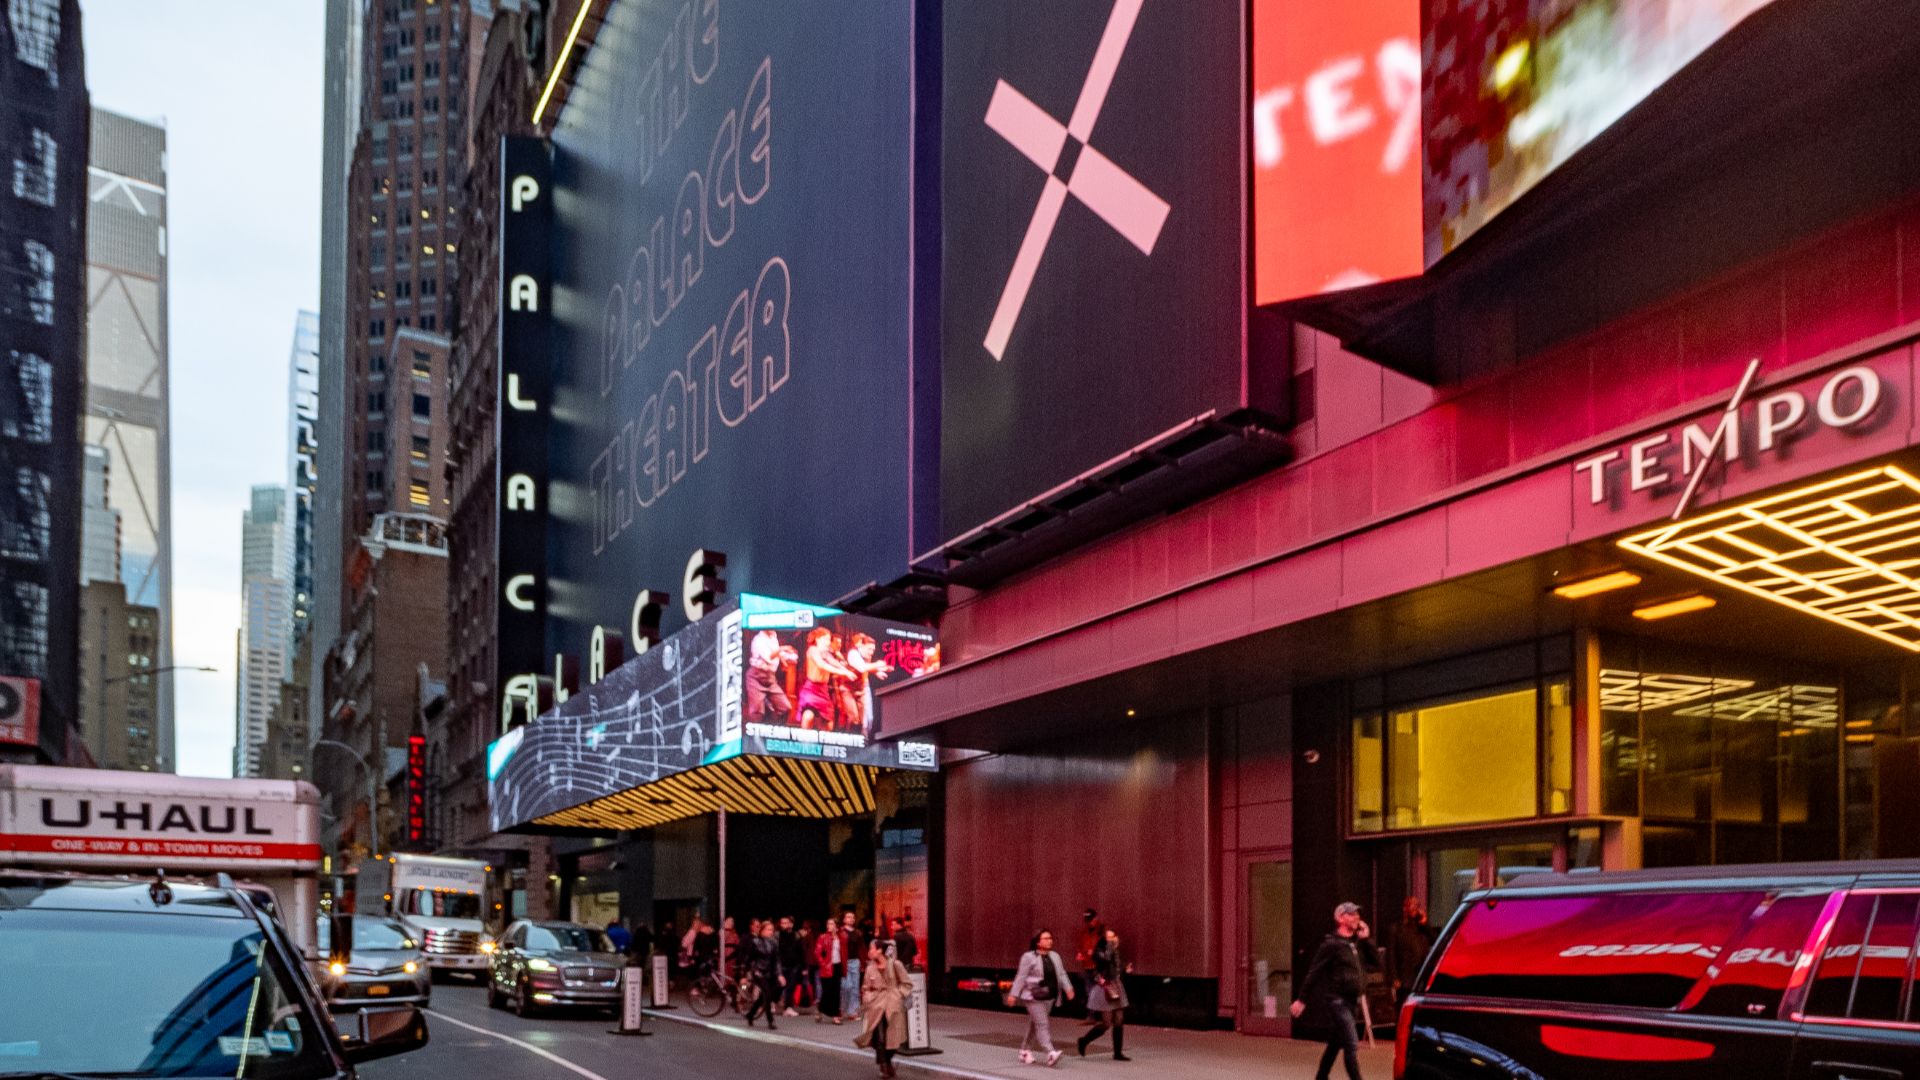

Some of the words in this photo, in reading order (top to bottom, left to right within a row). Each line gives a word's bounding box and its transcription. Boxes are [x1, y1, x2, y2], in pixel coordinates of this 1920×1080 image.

[600, 55, 772, 398] PALACE
[589, 256, 791, 557] THEATER
[1575, 358, 1882, 520] TEMPO
[40, 797, 273, 836] U-HAUL
[51, 838, 124, 852] ONE-WAY
[127, 841, 140, 852] &
[142, 841, 209, 854] IN-TOWN
[211, 844, 264, 856] MOVES
